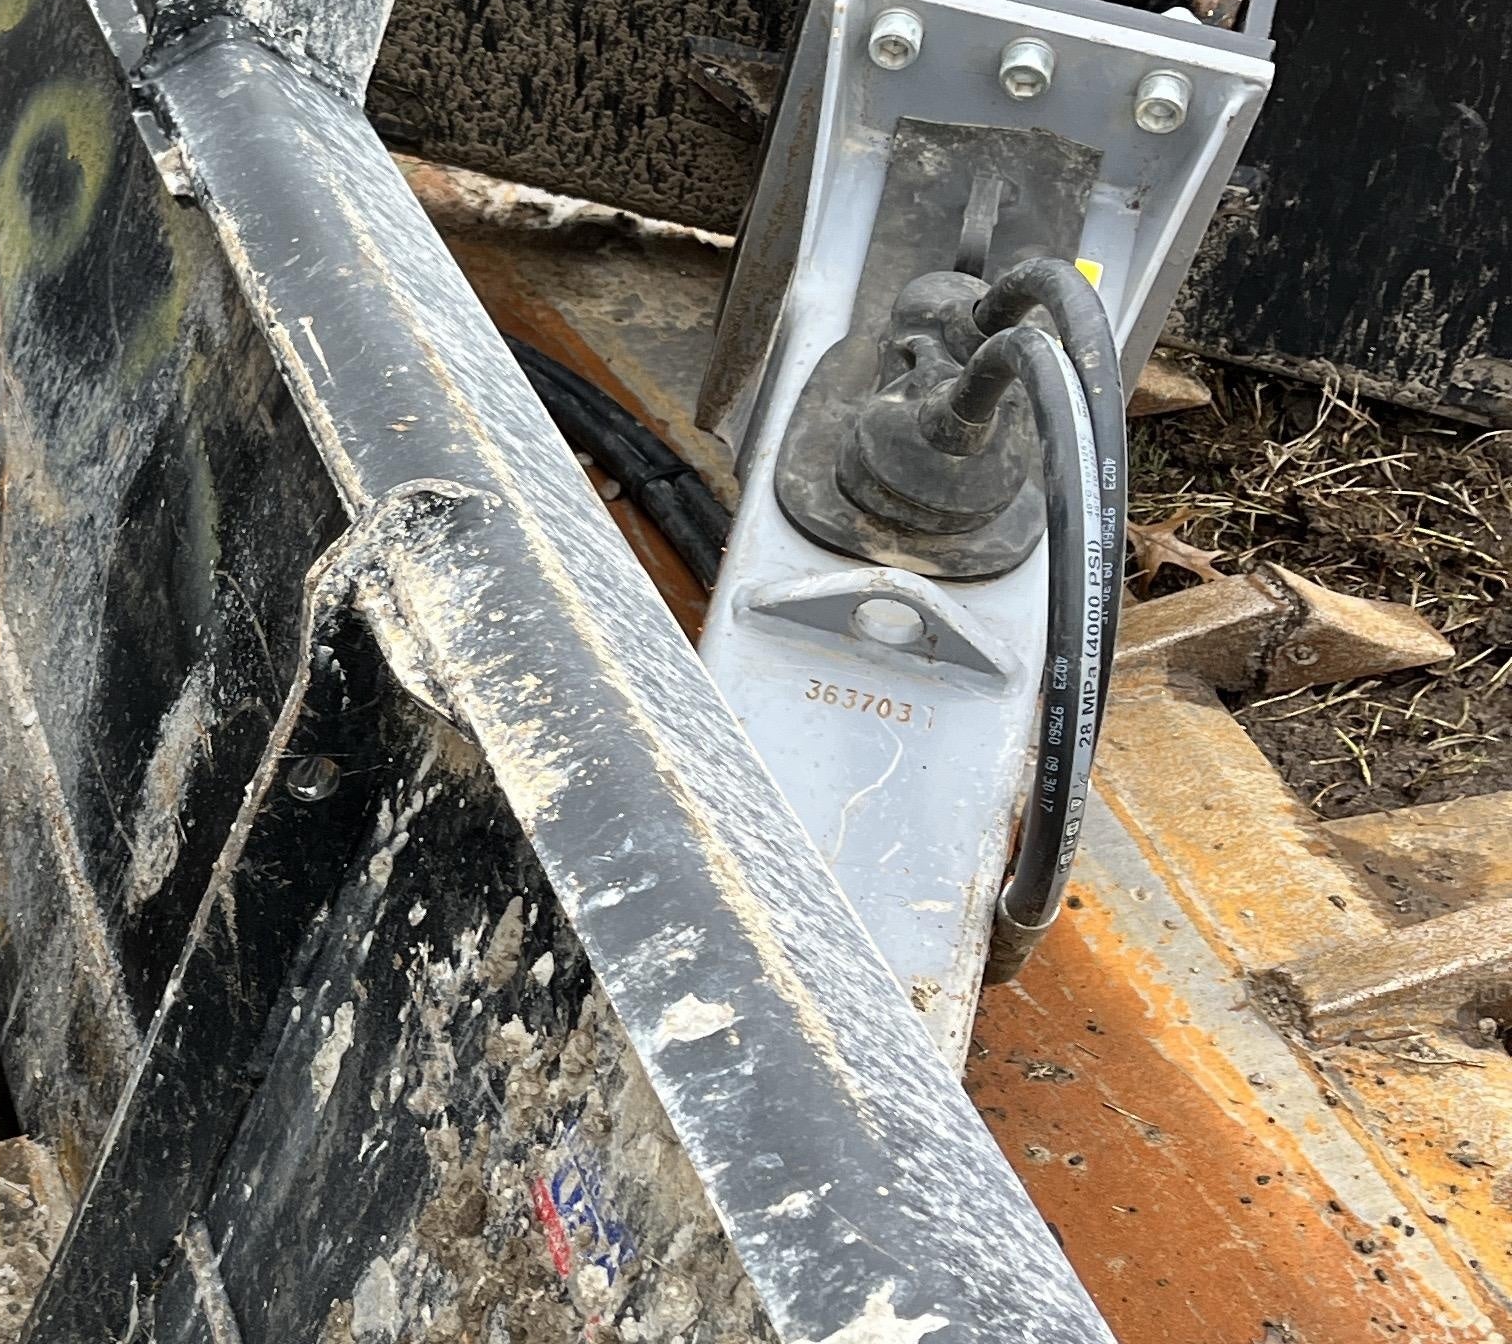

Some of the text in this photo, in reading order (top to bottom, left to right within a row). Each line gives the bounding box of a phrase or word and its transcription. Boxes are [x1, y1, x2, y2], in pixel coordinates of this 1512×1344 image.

[1102, 457, 1117, 491] 4023
[1079, 540, 1102, 748] 28 MPa (4000 PSI)
[1052, 655, 1069, 691] 4023
